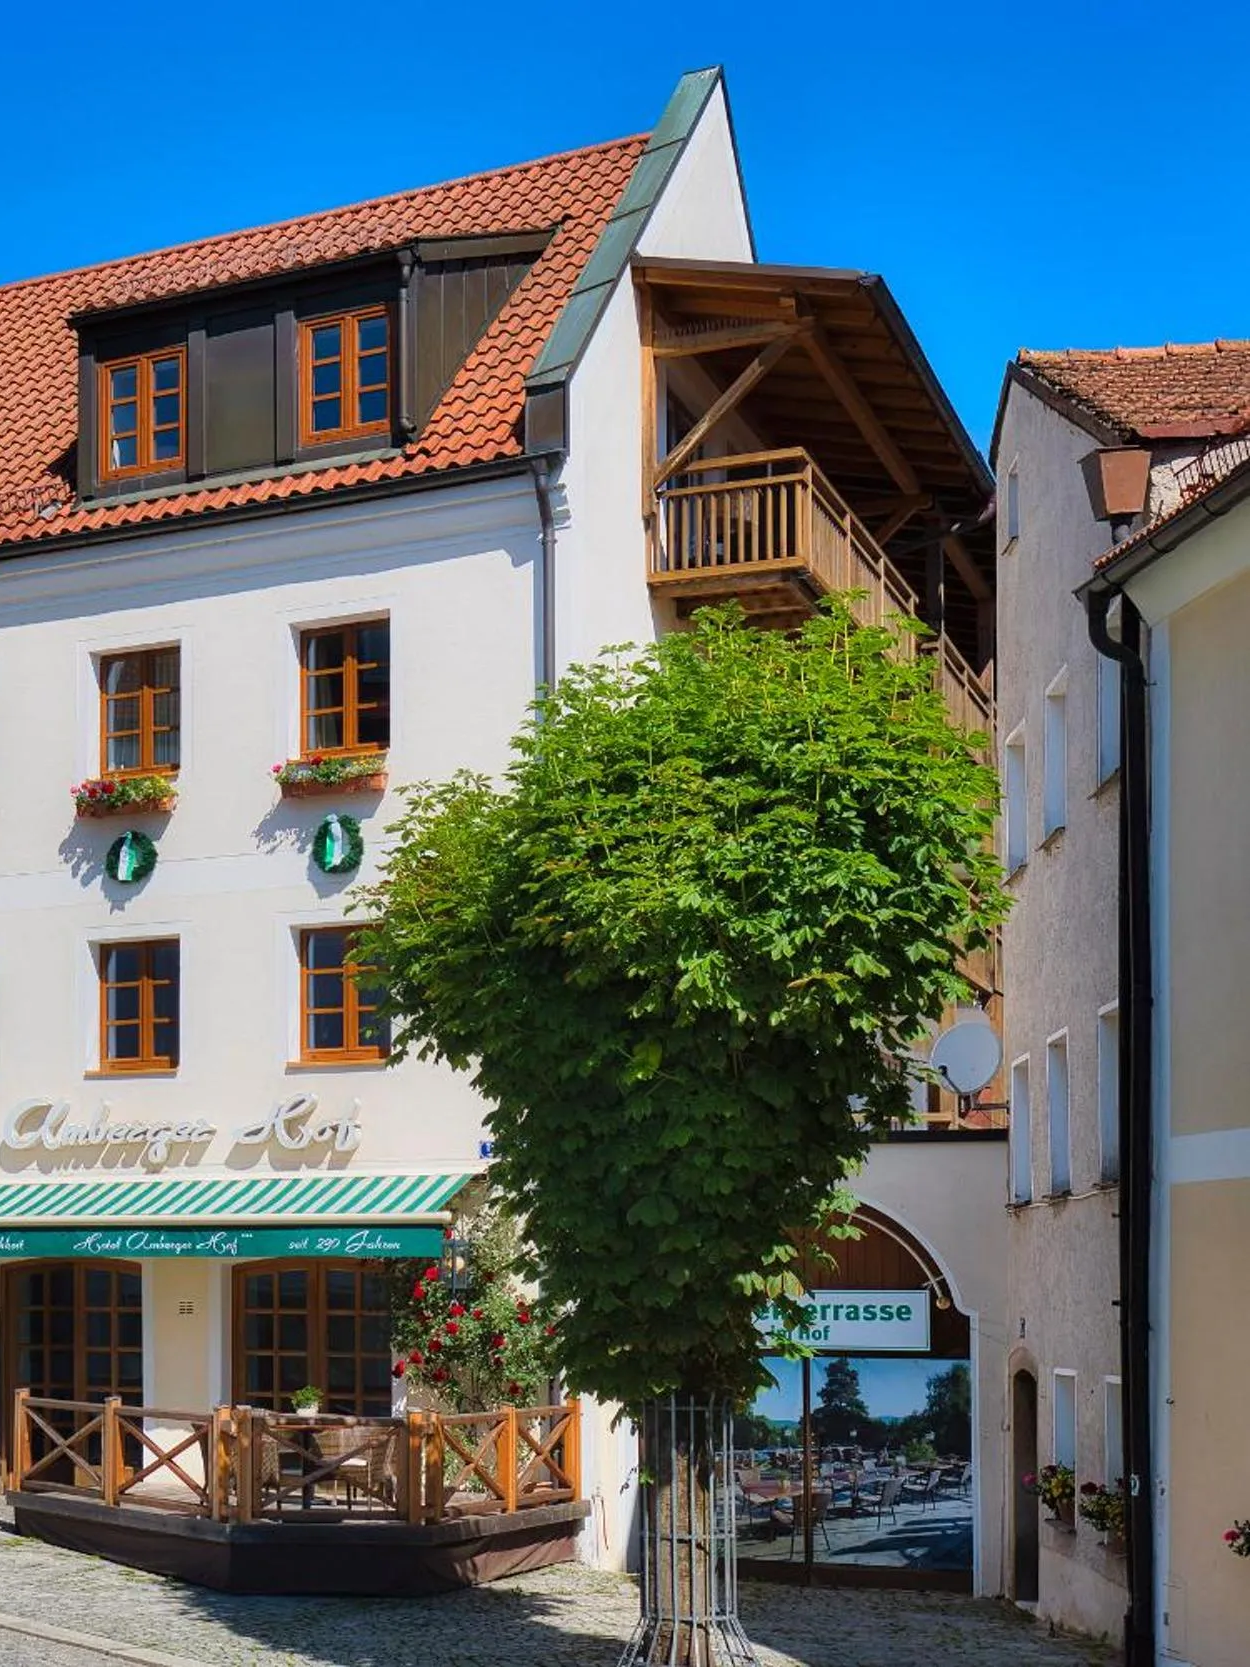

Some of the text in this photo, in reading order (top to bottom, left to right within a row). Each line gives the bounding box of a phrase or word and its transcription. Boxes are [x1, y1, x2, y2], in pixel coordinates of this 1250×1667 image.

[0, 1092, 362, 1164] Amberger Hof
[73, 1232, 121, 1253] Hotel
[126, 1231, 192, 1254] Amberger
[196, 1232, 238, 1255] Hof
[288, 1238, 310, 1249] seit
[344, 1229, 400, 1253] Jahren
[798, 1326, 830, 1341] Hof
